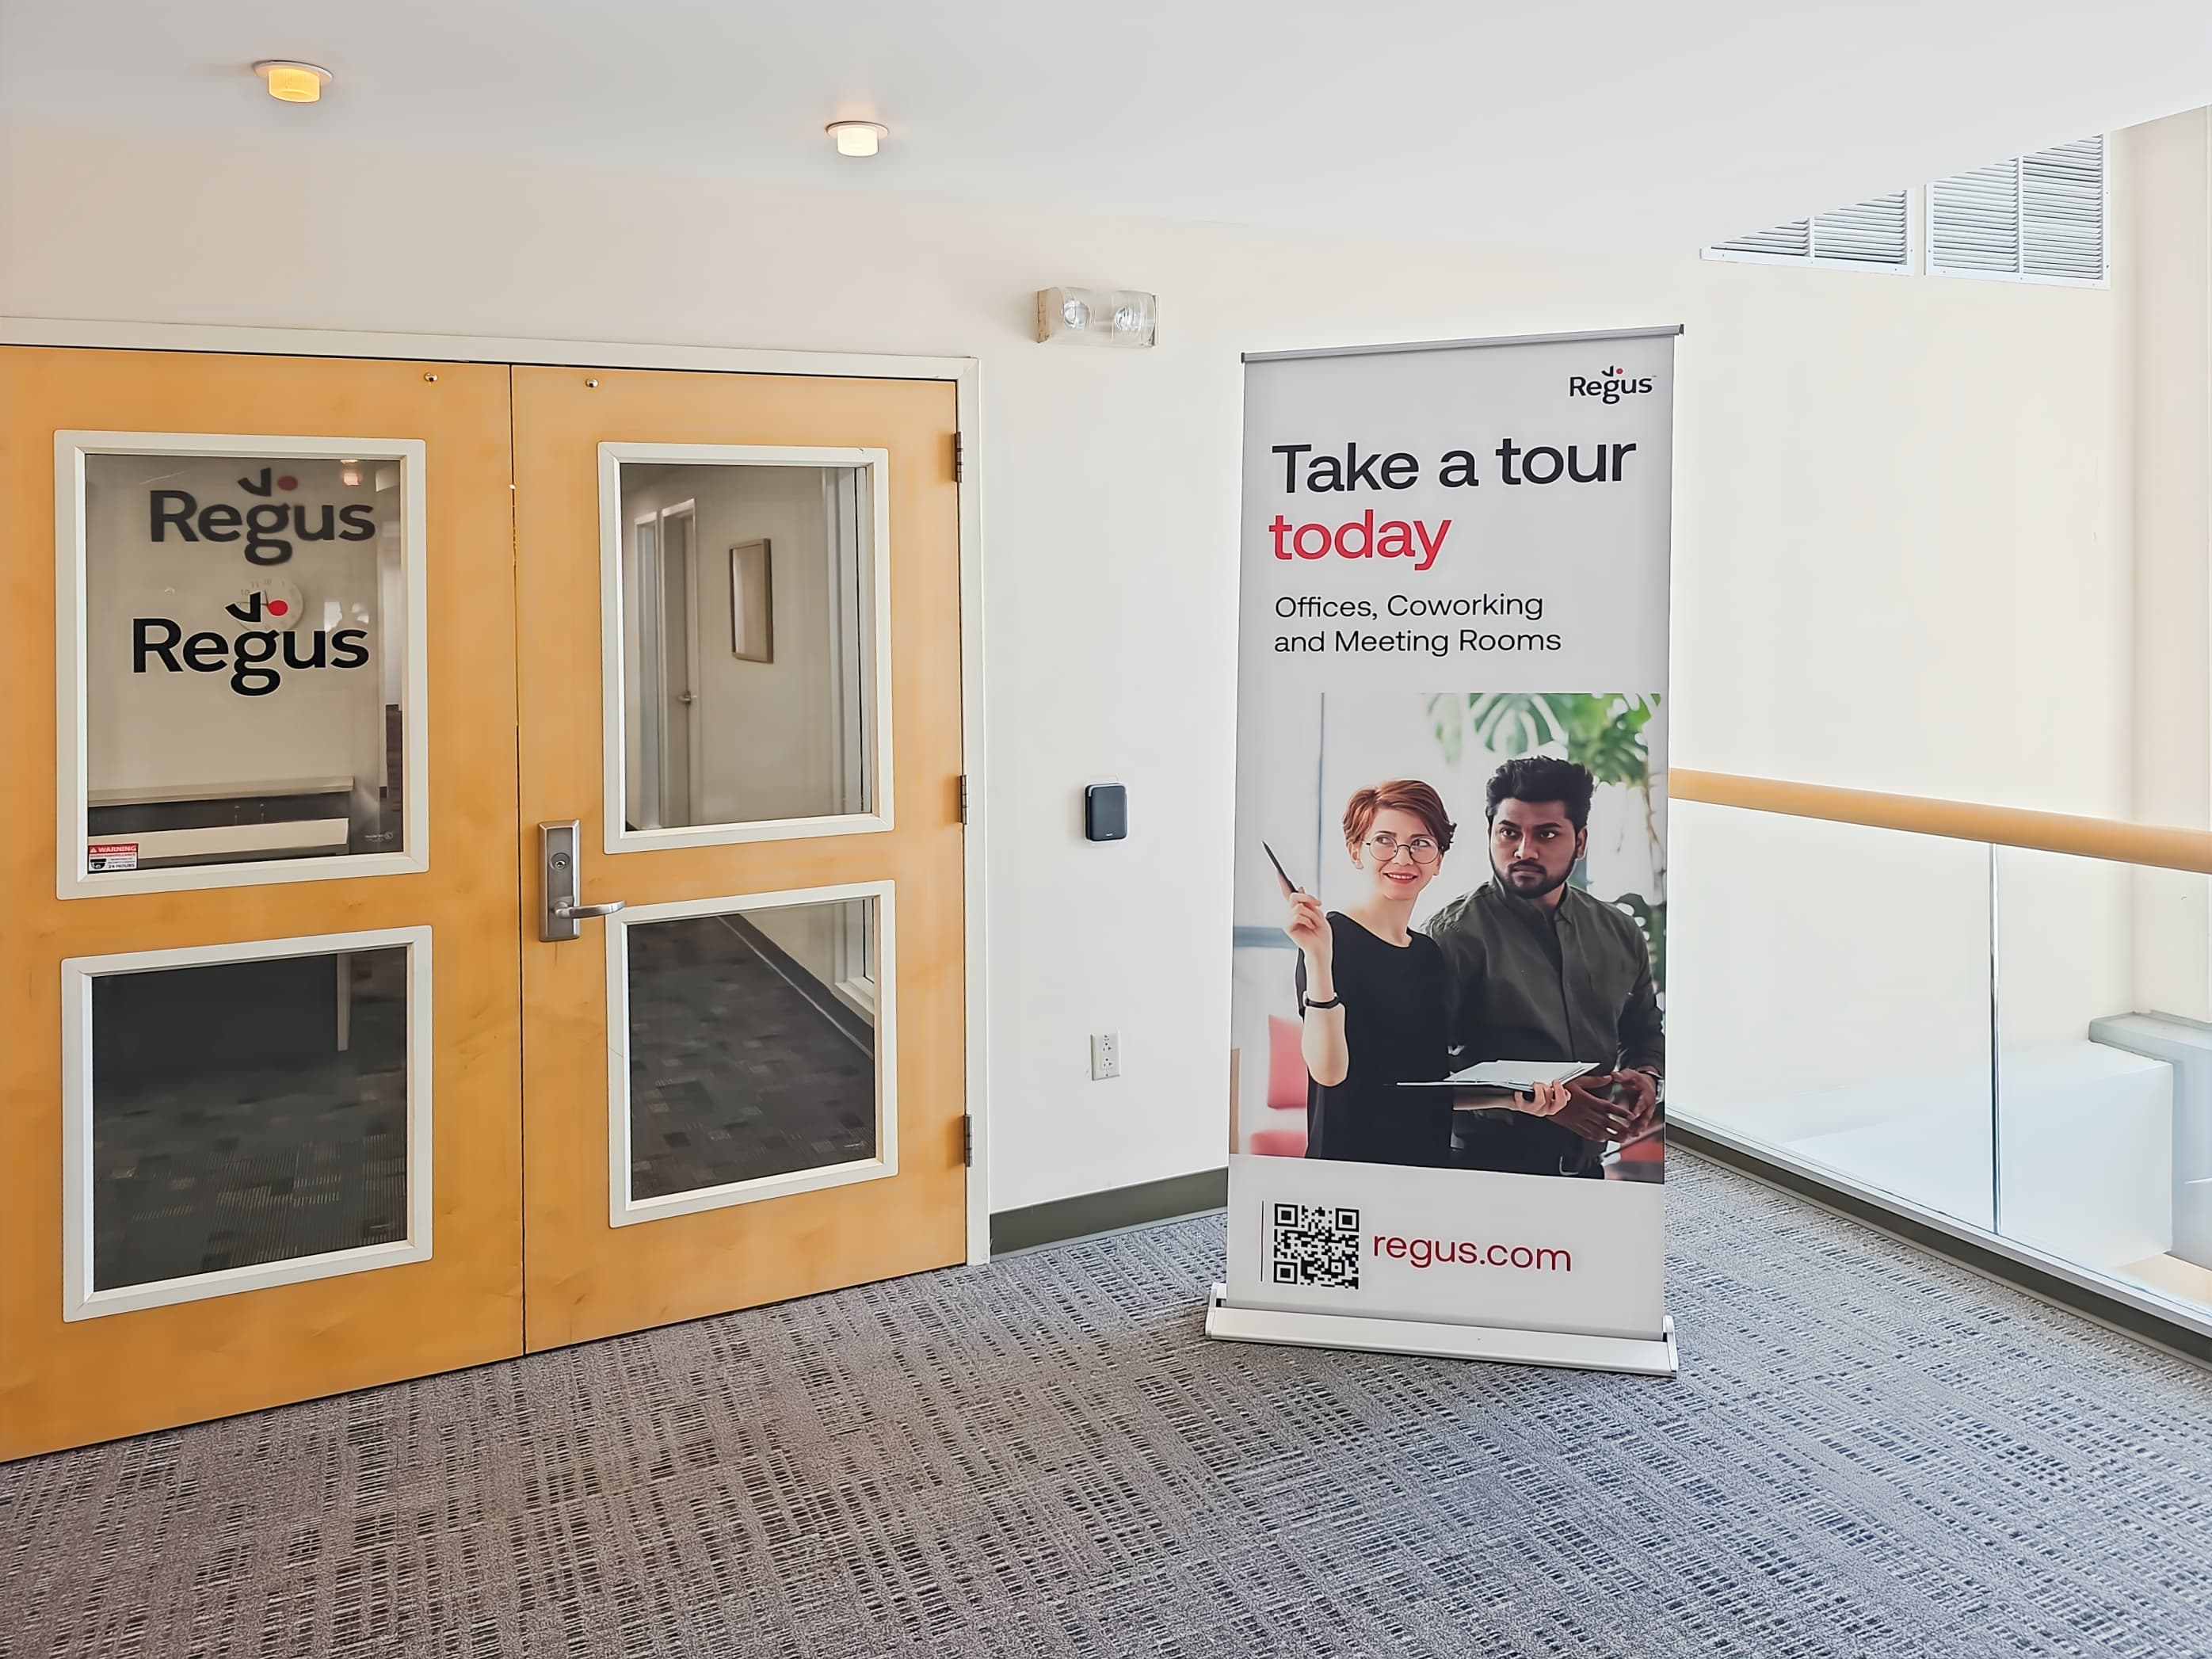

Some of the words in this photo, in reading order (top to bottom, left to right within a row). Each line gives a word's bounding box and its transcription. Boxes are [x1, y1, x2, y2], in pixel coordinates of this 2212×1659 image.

[1569, 376, 1653, 405] Regus
[1272, 441, 1420, 494] Take
[1438, 449, 1479, 488] a
[1495, 437, 1637, 486] tour
[149, 489, 376, 566] Regus
[1268, 508, 1452, 571] today
[1275, 596, 1378, 620] Offices,
[1387, 593, 1543, 621] Coworking
[132, 617, 370, 696] Regus
[1274, 631, 1325, 653] and
[1335, 630, 1448, 658] Meeting
[1459, 629, 1562, 651] Rooms
[1374, 1235, 1572, 1272] regus.com
